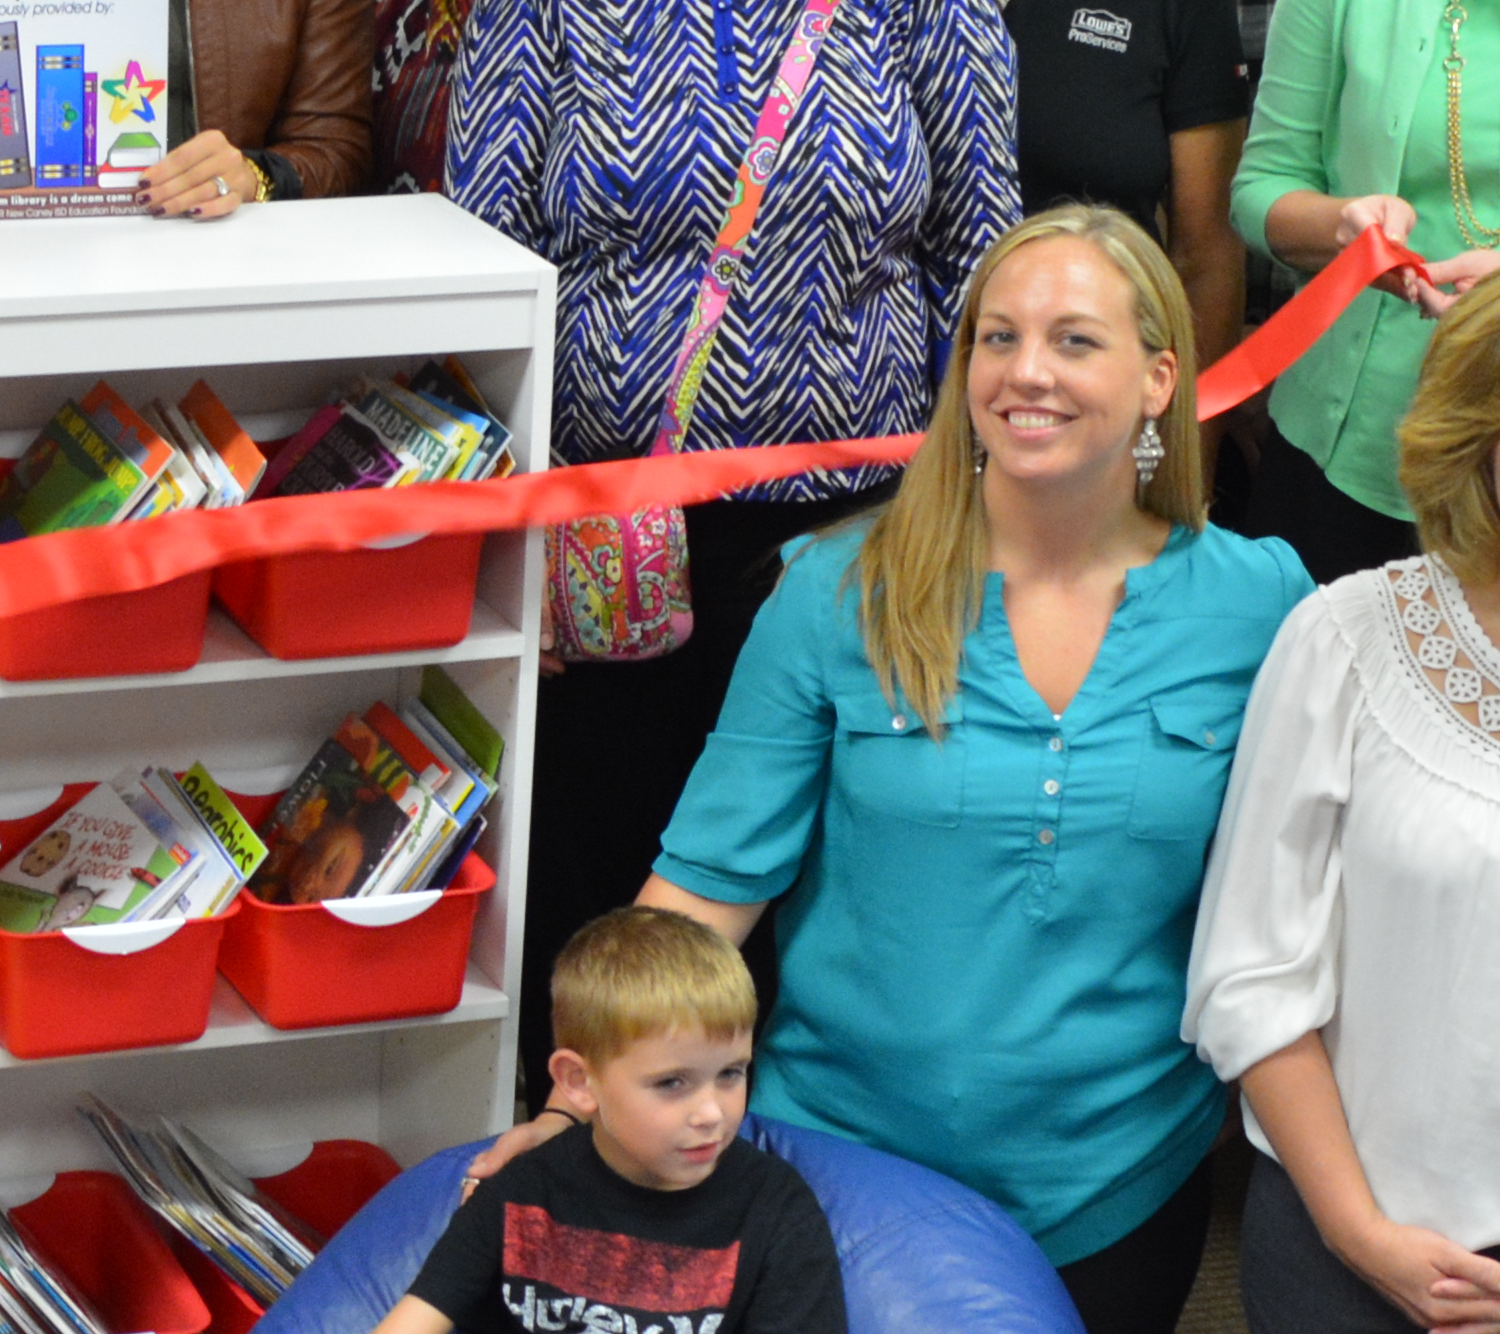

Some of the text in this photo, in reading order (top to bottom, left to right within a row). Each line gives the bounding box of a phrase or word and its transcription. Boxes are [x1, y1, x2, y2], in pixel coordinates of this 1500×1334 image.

[32, 0, 93, 17] provided
[95, 0, 115, 16] by:
[1079, 12, 1125, 36] LOWE'S
[1068, 28, 1128, 54] ProServices
[10, 195, 47, 206] library
[50, 195, 58, 204] is
[61, 196, 68, 204] a
[70, 194, 104, 204] dream
[106, 194, 132, 203] come
[69, 206, 109, 216] Education
[366, 397, 447, 470] MADELINE
[329, 425, 377, 474] HAROLD
[63, 812, 137, 841] IF YOU GIVE
[88, 841, 131, 861] MOUSE
[78, 860, 124, 880] COOKIE
